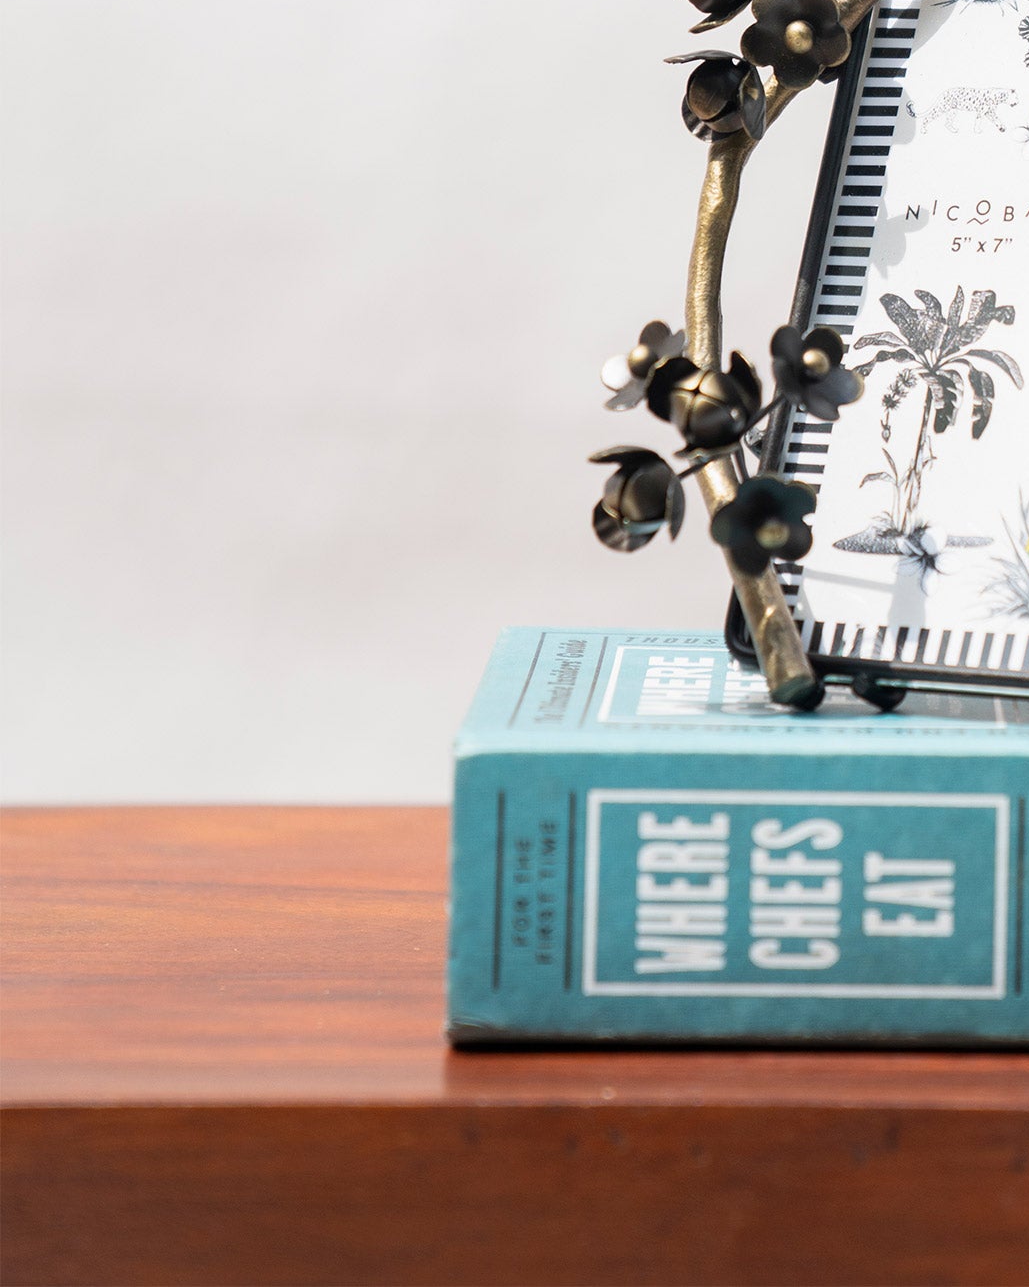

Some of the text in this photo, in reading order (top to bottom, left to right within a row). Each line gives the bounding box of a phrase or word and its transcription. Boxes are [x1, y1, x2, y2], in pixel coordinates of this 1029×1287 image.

[556, 639, 588, 659] Guide
[635, 655, 715, 715] WHERE
[512, 896, 531, 948] FOR
[535, 820, 558, 965] FIRST TIME
[634, 811, 731, 975] WHERE
[748, 817, 844, 970] CHEFS
[862, 851, 956, 938] EAT
